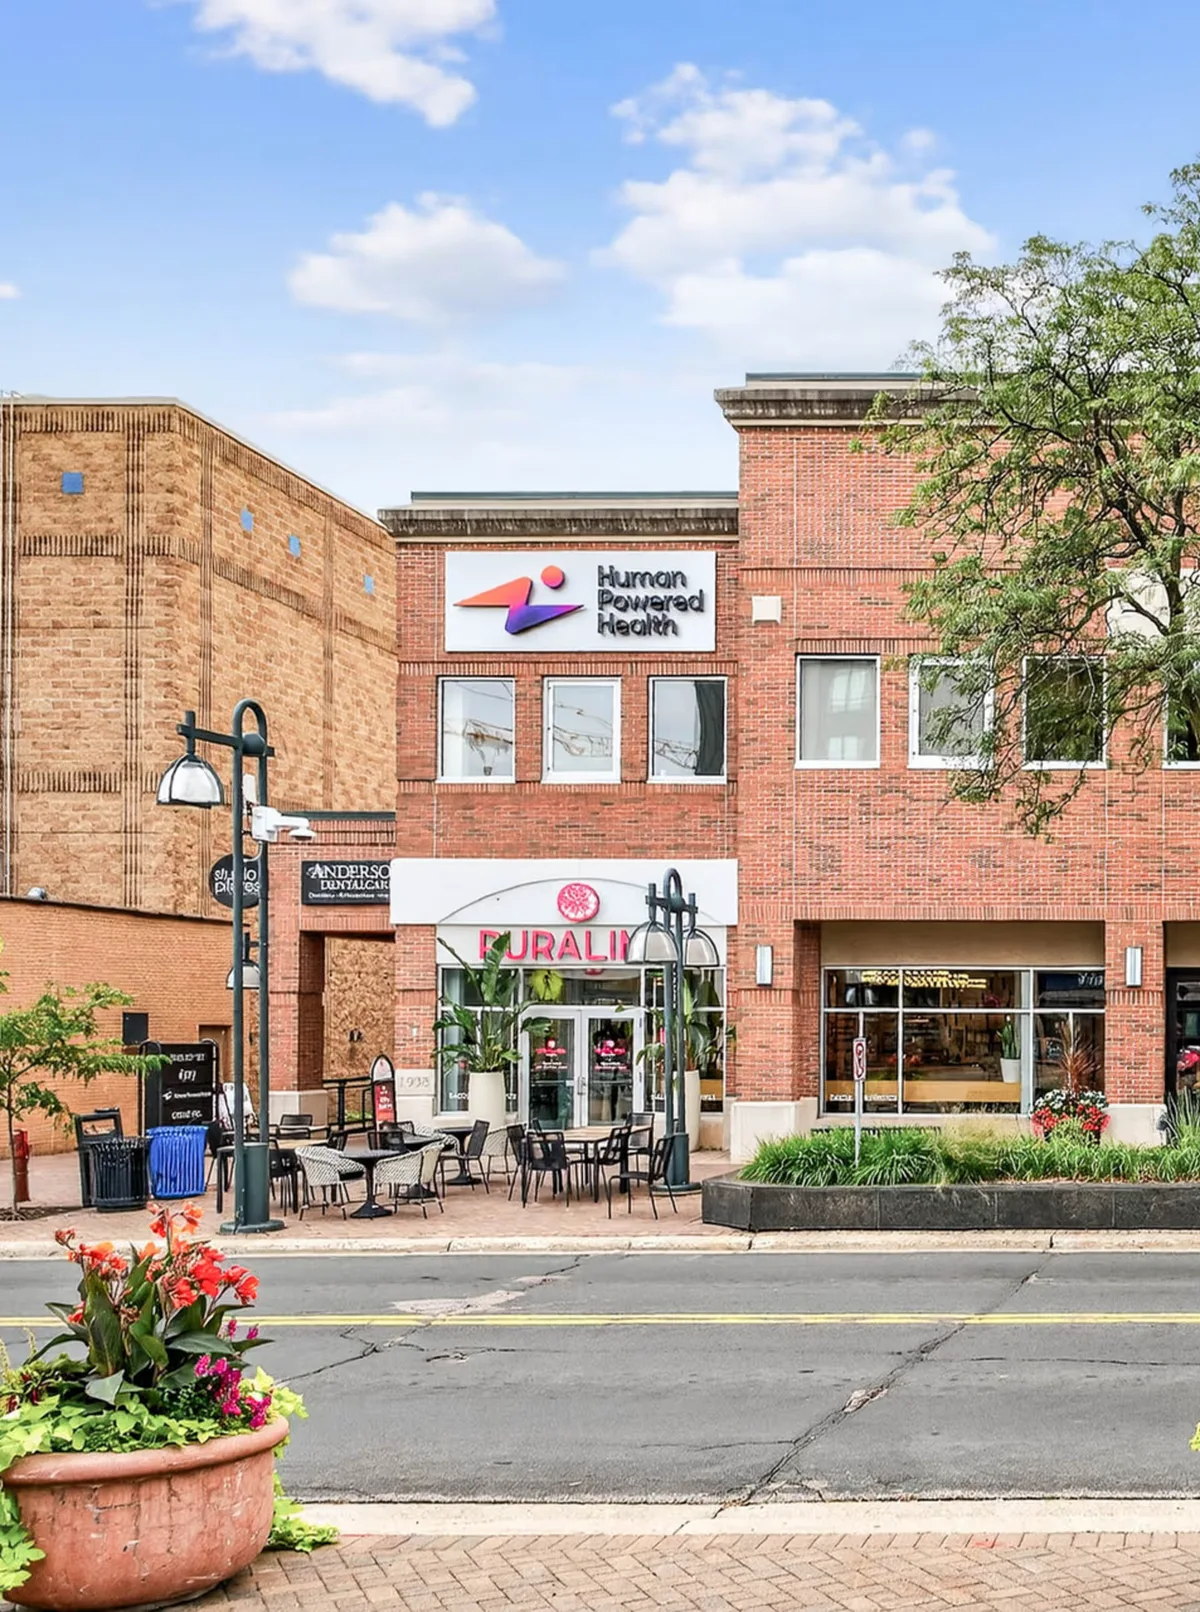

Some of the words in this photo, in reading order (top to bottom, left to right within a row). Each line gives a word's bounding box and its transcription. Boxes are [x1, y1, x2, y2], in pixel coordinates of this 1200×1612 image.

[598, 564, 688, 589] Human
[598, 588, 705, 613] Powered
[598, 612, 679, 637] Health
[310, 863, 391, 879] ANDERSO
[364, 880, 390, 890] CAR
